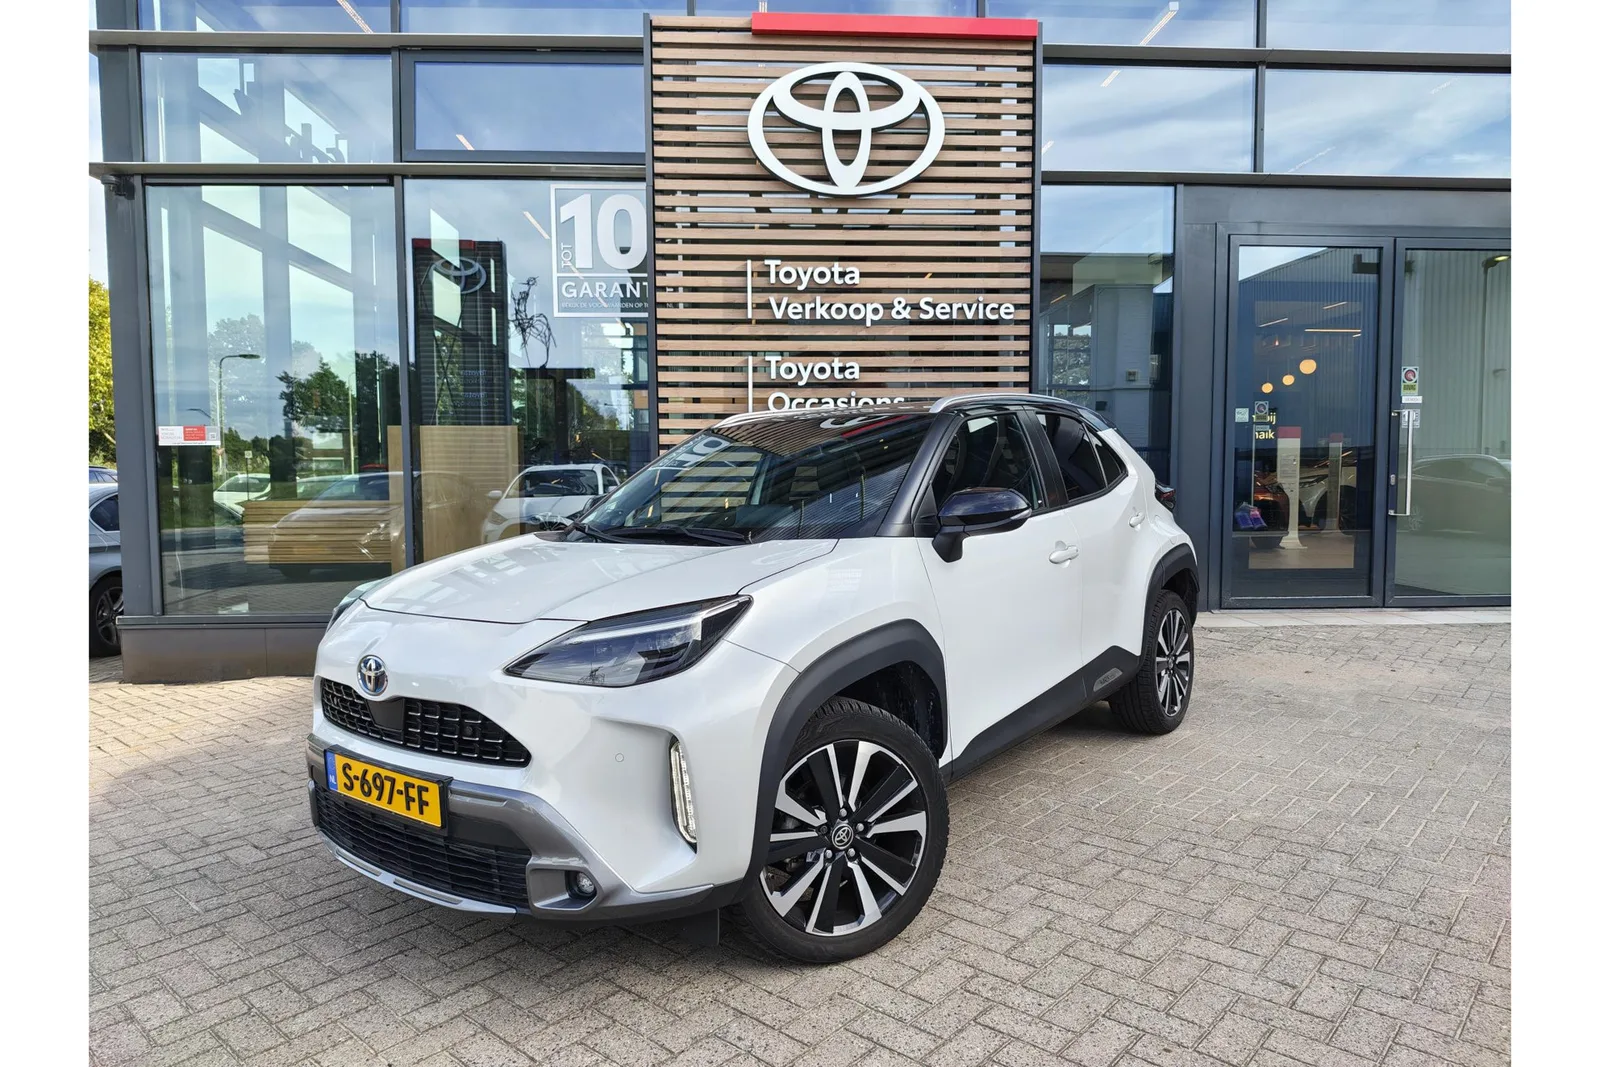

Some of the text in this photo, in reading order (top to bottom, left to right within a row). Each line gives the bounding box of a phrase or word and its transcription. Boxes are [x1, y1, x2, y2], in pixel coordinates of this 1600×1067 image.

[559, 193, 648, 270] 10
[561, 243, 573, 268] TOT
[764, 259, 860, 290] Toyota
[769, 296, 1015, 327] Verkoop & Service
[764, 355, 860, 386] Toyota
[329, 774, 337, 785] NL
[342, 763, 430, 815] S-697-FF
